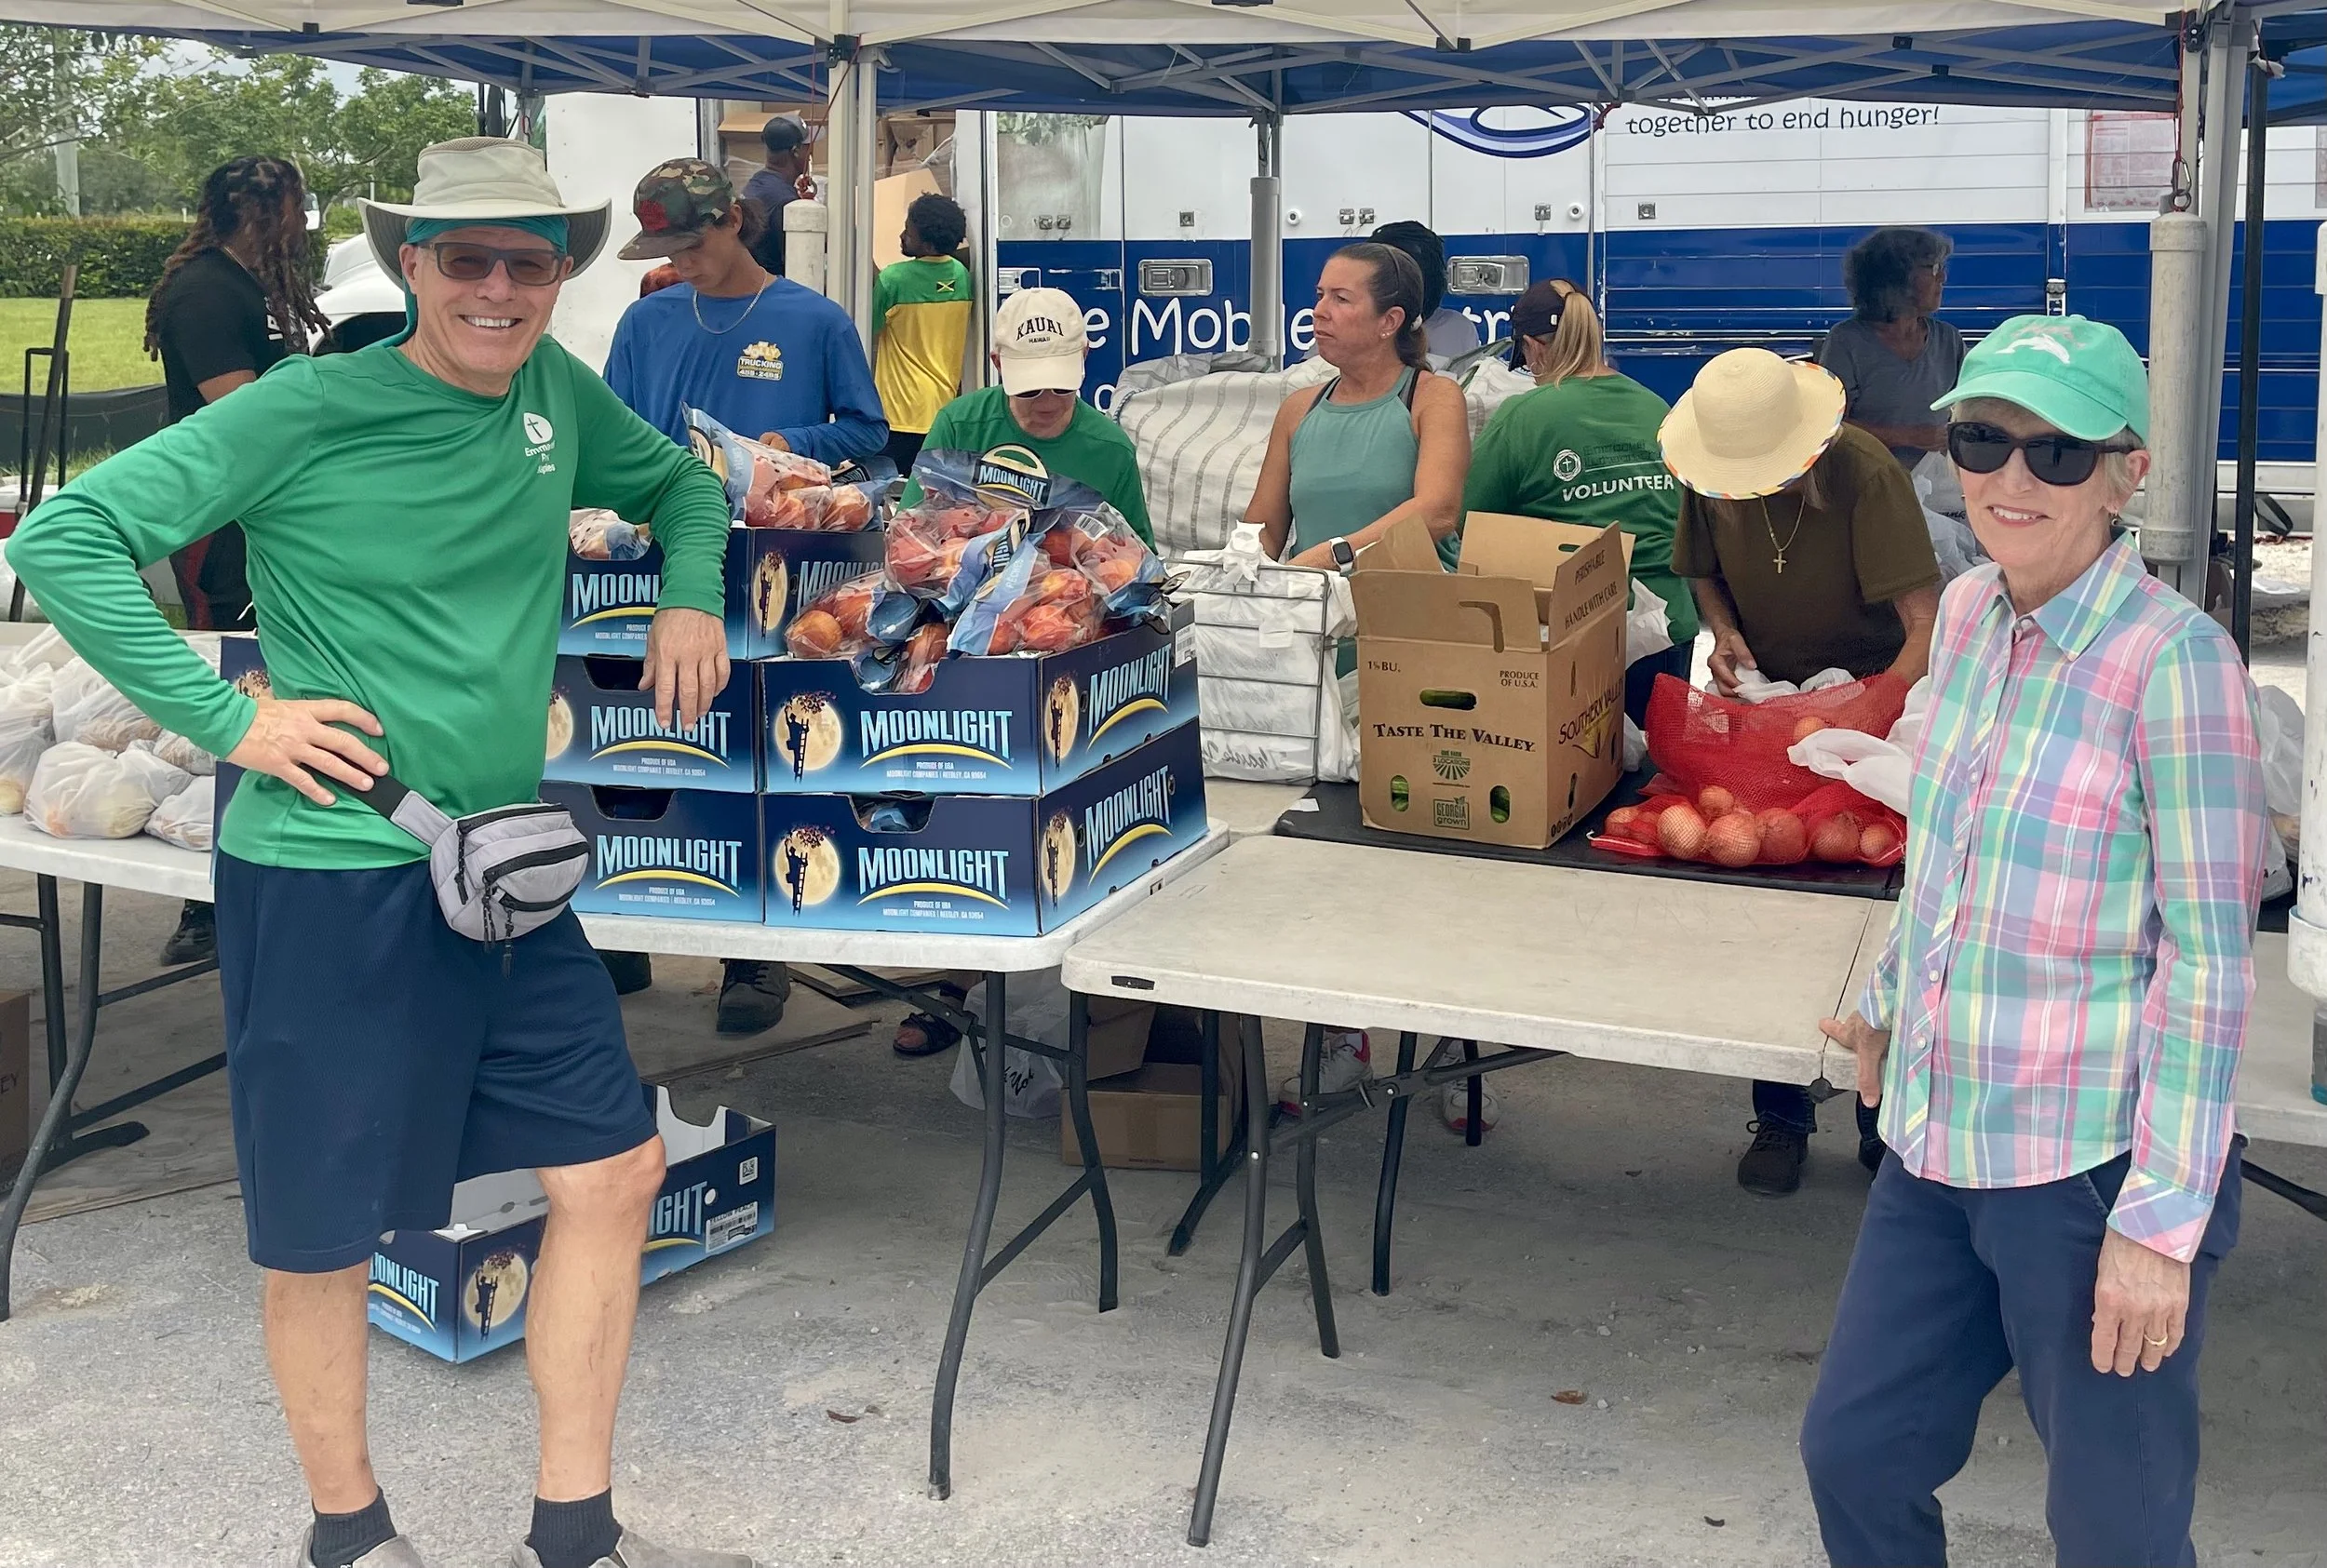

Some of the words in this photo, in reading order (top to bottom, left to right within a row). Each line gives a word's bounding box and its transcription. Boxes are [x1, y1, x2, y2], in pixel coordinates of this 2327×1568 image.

[1626, 113, 1737, 137] together
[1745, 113, 1773, 129] to
[1782, 107, 1829, 129] end
[1840, 105, 1940, 129] hunger!
[1016, 316, 1064, 341] KAUAI
[741, 359, 782, 369] TRUCKING
[977, 464, 1047, 503] MOONLIGHT
[1563, 474, 1675, 503] VOLUNTEER
[572, 573, 660, 620] MOONL
[1588, 591, 1606, 612] WITH
[1500, 670, 1540, 680] PRODUCE
[1500, 678, 1513, 687] OF
[1514, 679, 1538, 688] U.S.A.
[1088, 643, 1172, 739] MOONLIGHT
[860, 710, 1013, 759] MOONLIGHT
[1558, 695, 1603, 744] SOUTHERN
[1373, 723, 1424, 738] TASTE
[1430, 723, 1466, 740] THE
[1472, 728, 1535, 752] VALLEY
[1085, 765, 1170, 872] MOONLIGHT
[1436, 802, 1466, 819] GEORGIA
[1436, 816, 1467, 826] grown
[597, 834, 742, 888] MOONLIGHT
[857, 847, 1009, 900] MOONLIGHT
